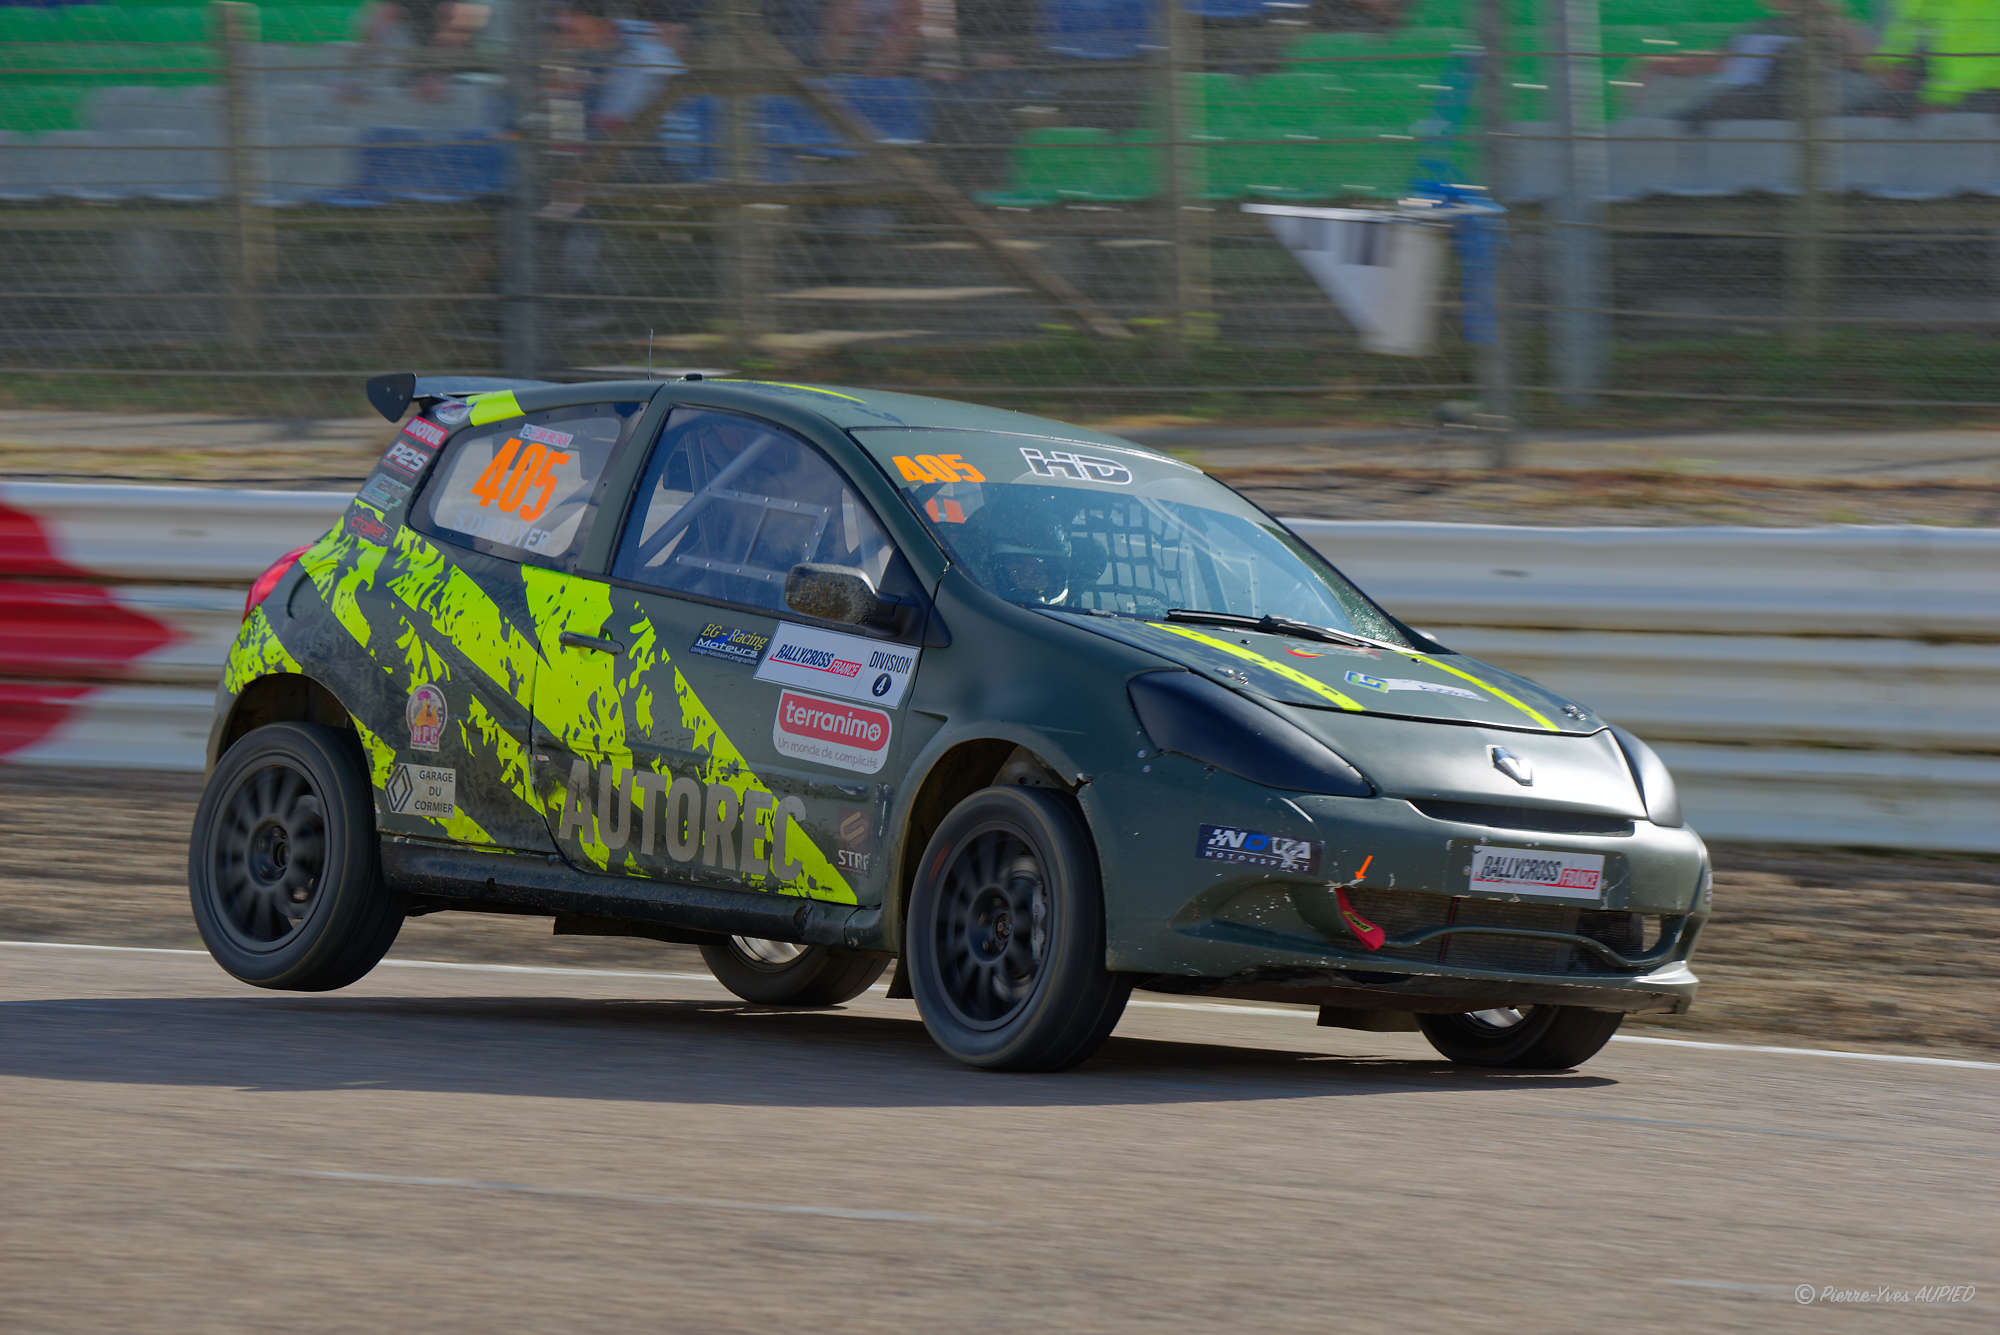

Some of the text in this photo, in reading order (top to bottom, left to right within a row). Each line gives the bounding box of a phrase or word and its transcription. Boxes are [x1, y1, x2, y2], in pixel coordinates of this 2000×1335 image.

[405, 418, 445, 446] MOTUL
[471, 437, 571, 522] 405
[891, 454, 986, 483] 405
[1019, 447, 1133, 485] HD
[695, 638, 759, 658] Moteurs
[701, 623, 722, 638] EG
[728, 628, 768, 650] Racing
[775, 644, 835, 668] RALLYCROSS
[830, 660, 861, 677] FRANCE
[869, 651, 912, 674] DIVISION
[876, 676, 888, 694] 4
[786, 700, 881, 741] terranimo
[777, 738, 790, 749] Un
[790, 741, 820, 757] monde
[821, 744, 833, 759] de
[419, 770, 454, 783] GARAGE
[428, 786, 442, 797] DU
[414, 800, 454, 814] CORMIER
[558, 759, 806, 881] AUTOREC
[1480, 855, 1600, 889] RALLYCROSS FRANCE
